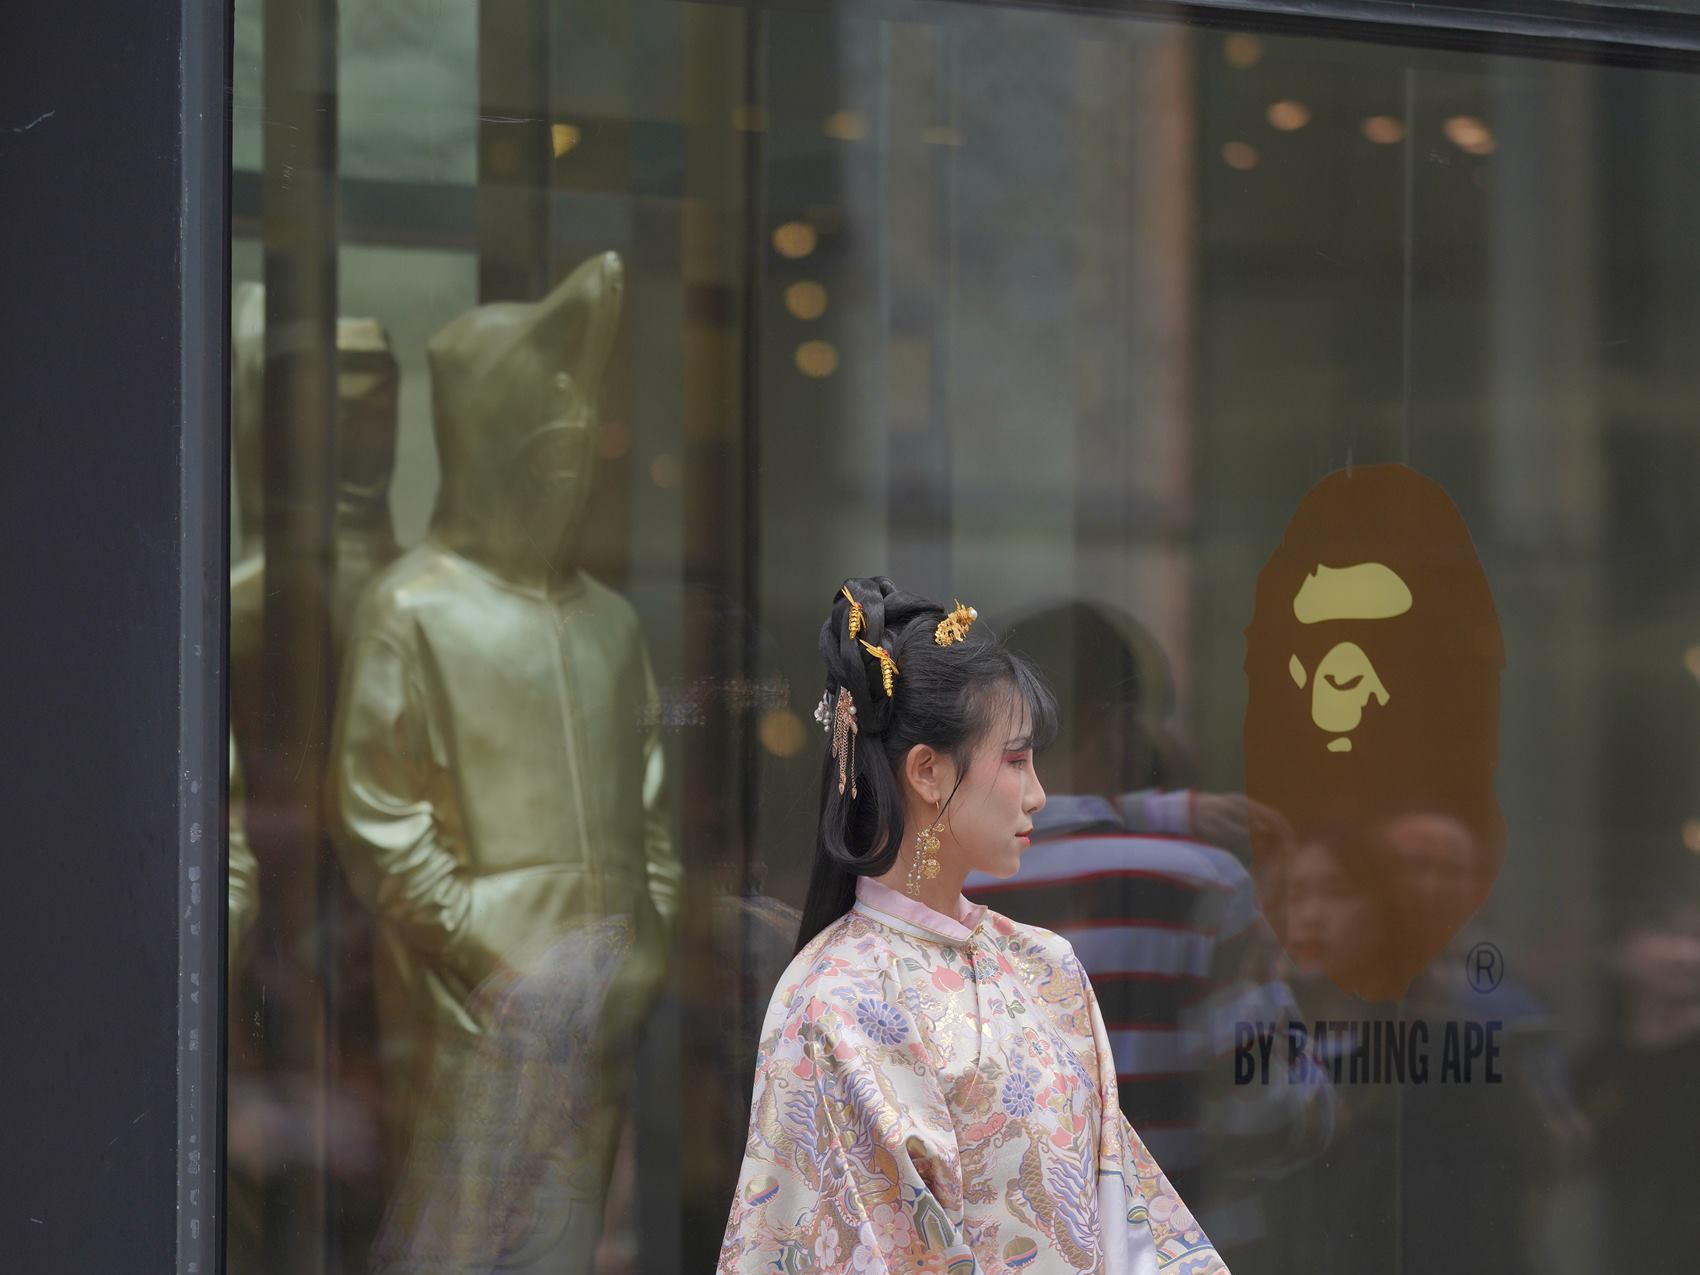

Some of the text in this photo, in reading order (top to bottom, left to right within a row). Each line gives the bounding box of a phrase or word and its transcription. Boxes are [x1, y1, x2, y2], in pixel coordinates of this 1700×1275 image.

[1234, 1019, 1503, 1086] BY BATHING APE
